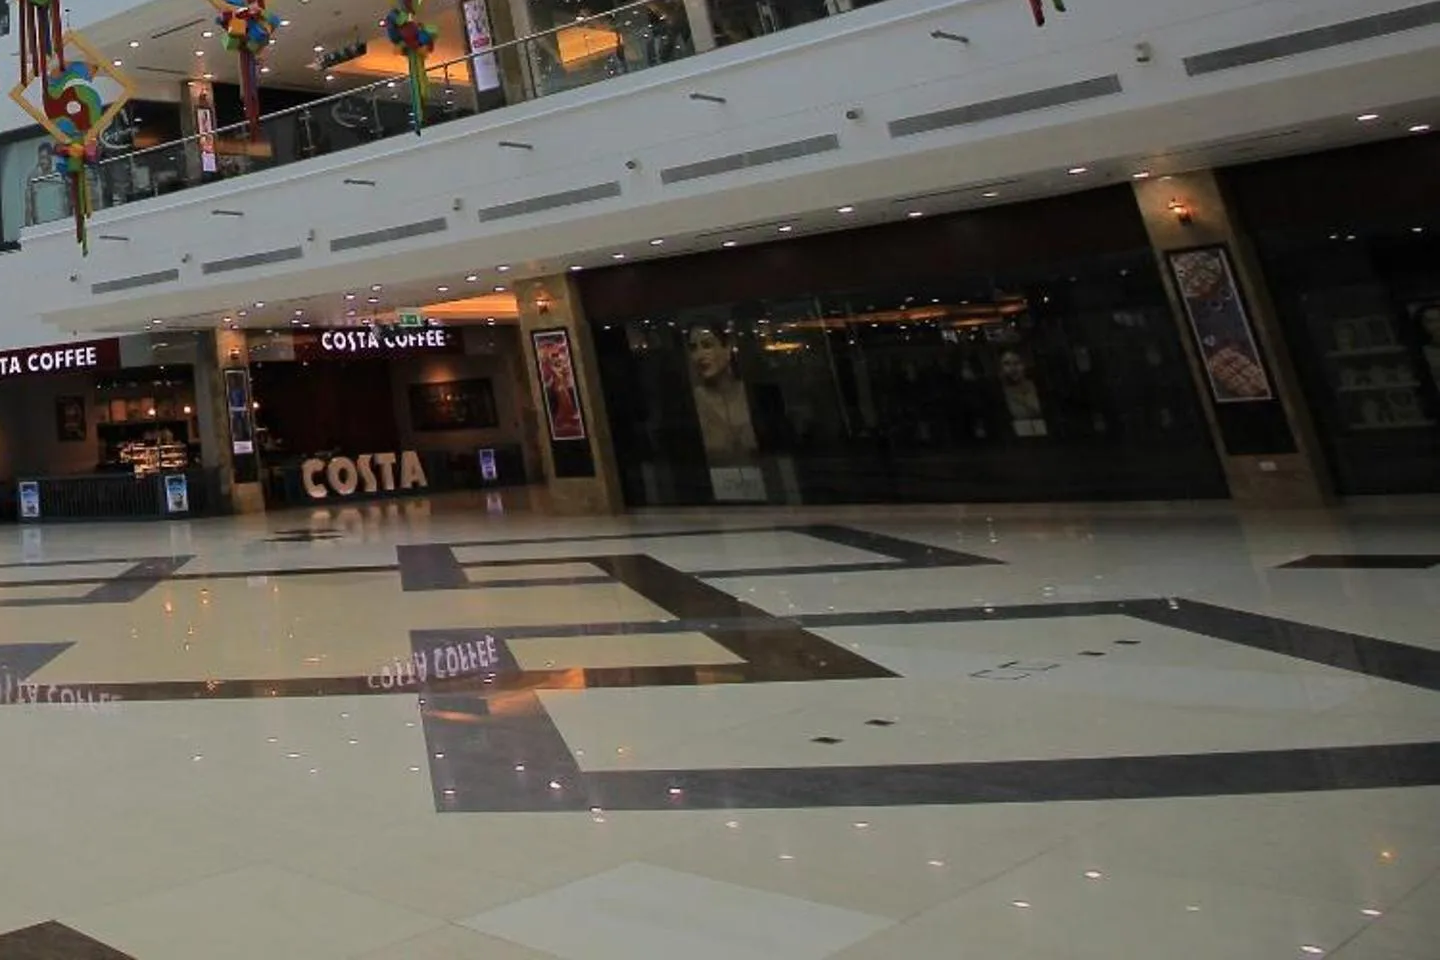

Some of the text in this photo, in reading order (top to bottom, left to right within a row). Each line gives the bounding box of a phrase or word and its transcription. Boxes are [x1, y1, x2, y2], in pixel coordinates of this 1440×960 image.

[322, 330, 380, 352] COSTA
[27, 346, 97, 372] COFFEE
[301, 449, 429, 498] COSTA
